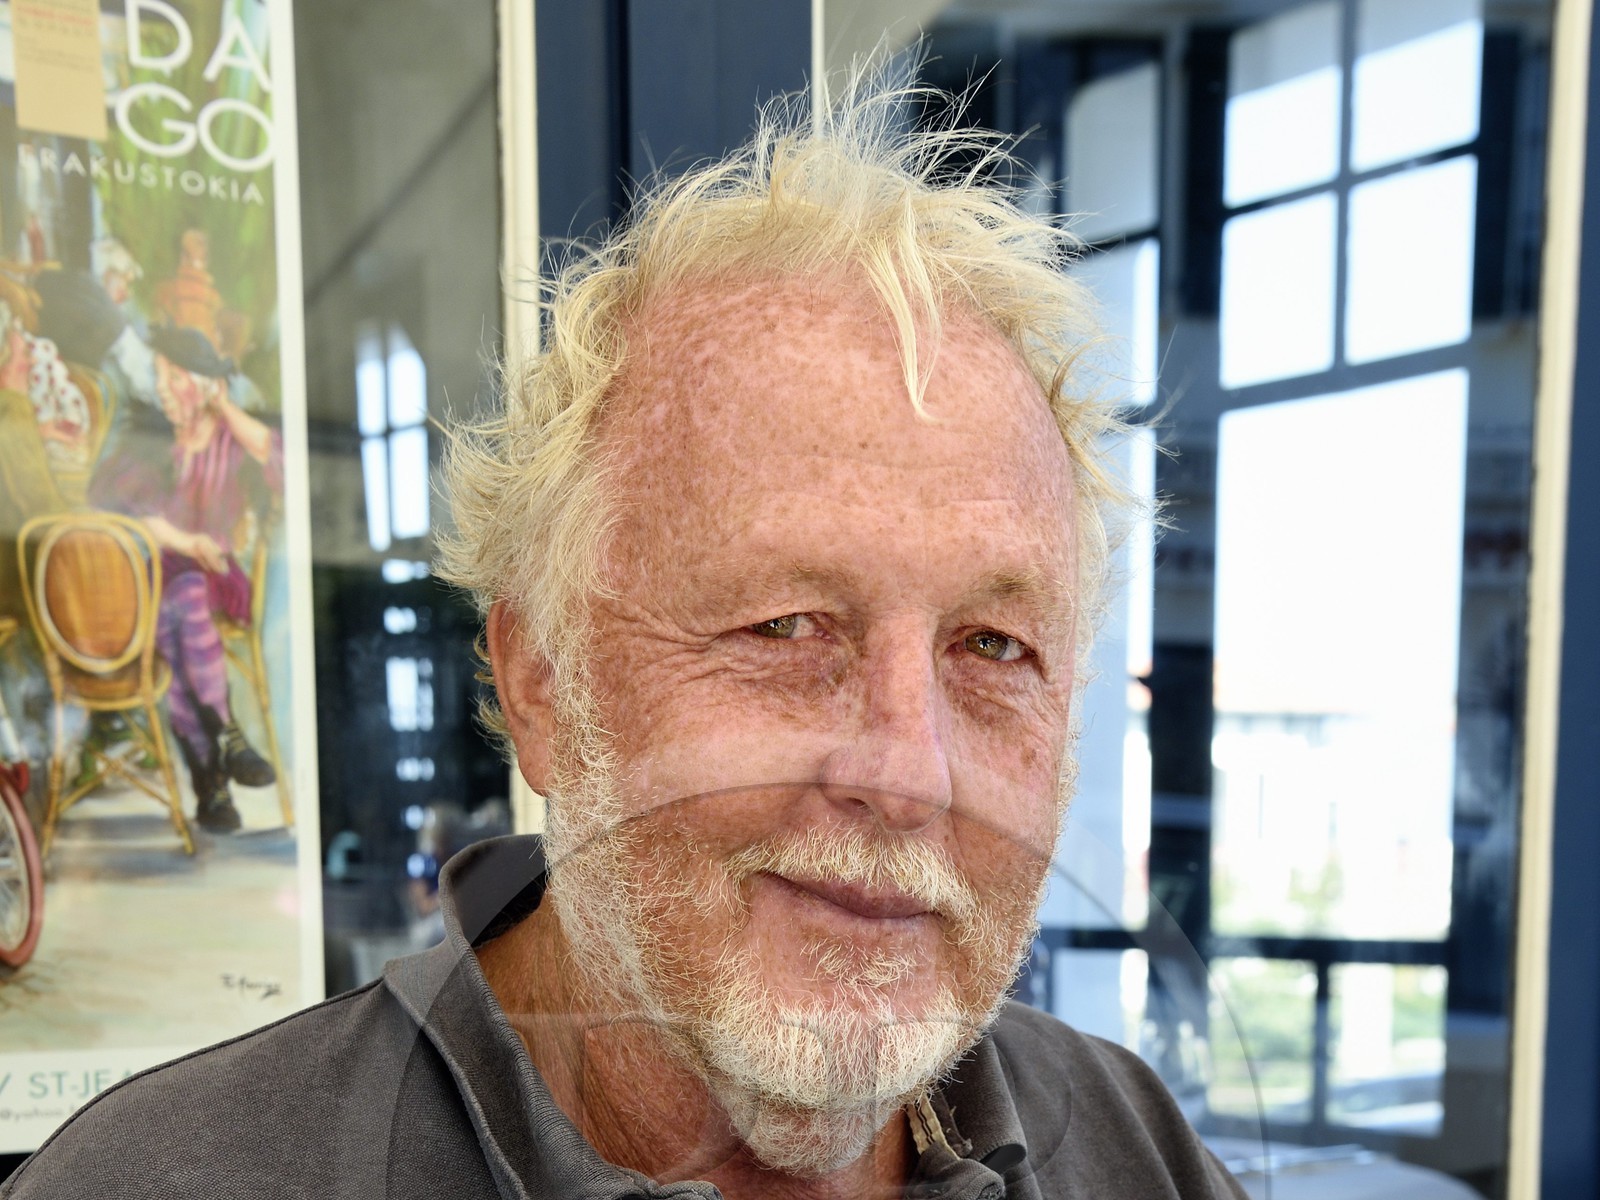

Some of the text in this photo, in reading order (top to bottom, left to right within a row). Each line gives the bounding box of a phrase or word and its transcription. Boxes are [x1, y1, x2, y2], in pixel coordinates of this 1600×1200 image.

[125, 0, 271, 91] DA
[115, 82, 275, 172] GO
[28, 1067, 132, 1099] ST-JE
